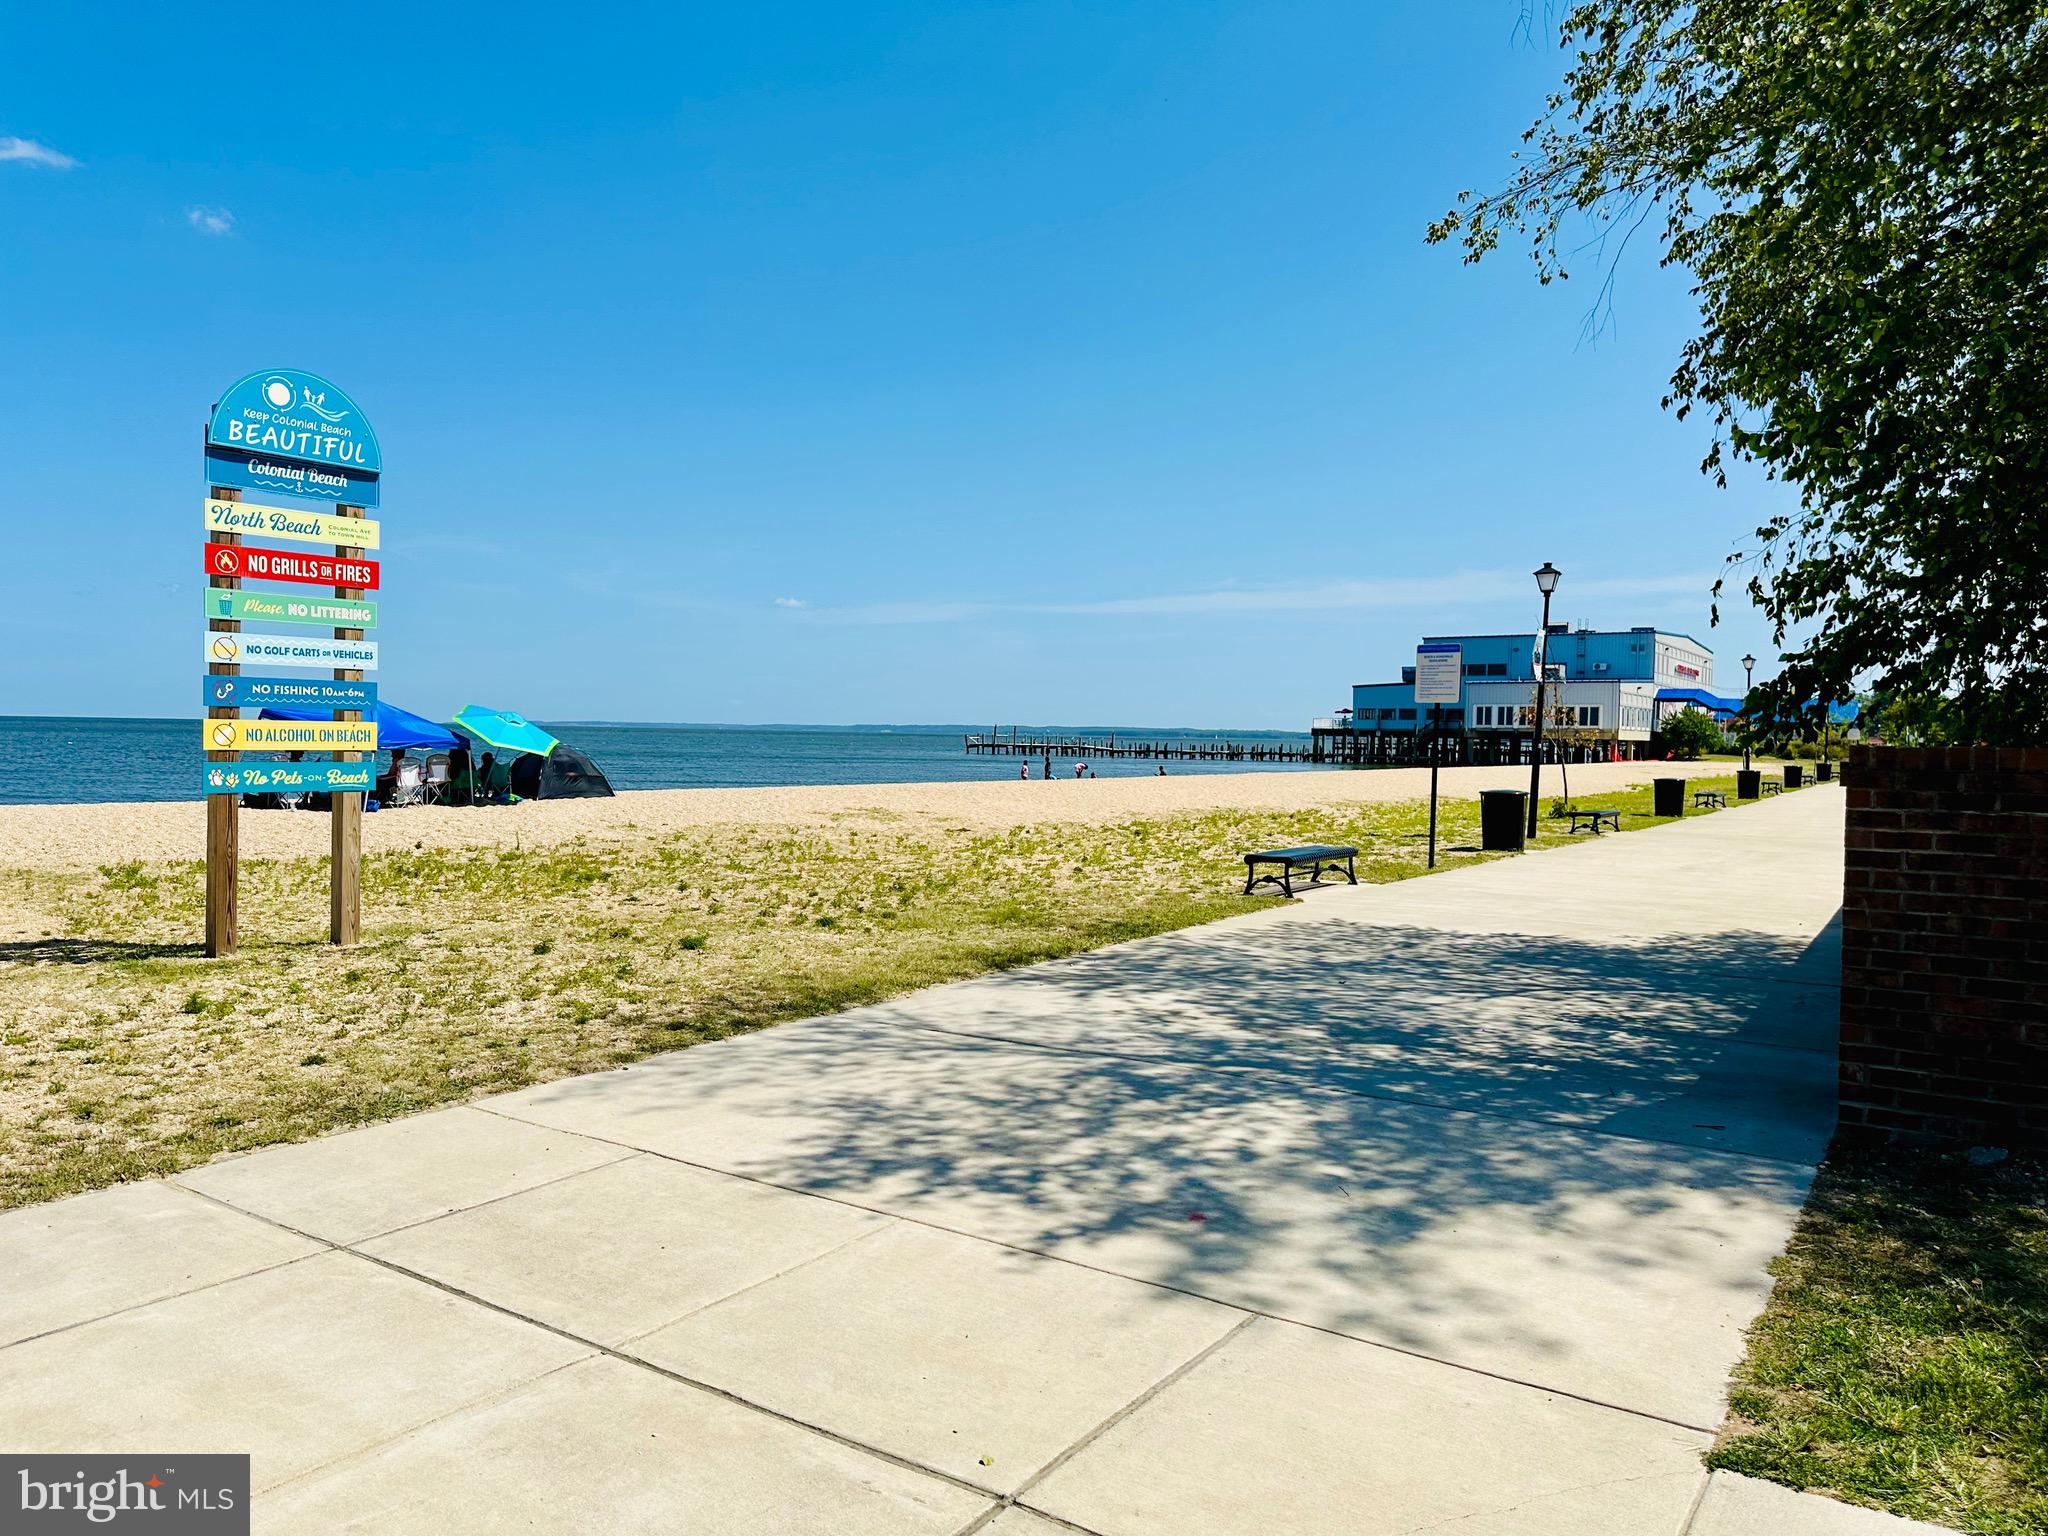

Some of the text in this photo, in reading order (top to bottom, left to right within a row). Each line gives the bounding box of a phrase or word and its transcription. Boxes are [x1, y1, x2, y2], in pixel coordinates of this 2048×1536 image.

[243, 407, 352, 438] Keep Colonial Beach
[229, 419, 366, 463] BEAUTIFUL
[248, 459, 348, 488] Colonial Beach
[211, 504, 322, 536] North Beach
[248, 554, 371, 584] NO GRILLS OR FIRES
[287, 603, 308, 617] NO
[310, 605, 372, 622] LITTERING
[246, 644, 262, 655] NO
[264, 646, 290, 656] GOLF
[292, 647, 321, 658] CARTS
[333, 650, 373, 660] VEHICLES
[252, 684, 365, 698] NO FISHING 10AM-6PM
[246, 728, 371, 743] NO ALCOHOL ON BEACH
[243, 769, 269, 786] No
[271, 769, 303, 785] Pets
[327, 768, 369, 784] Beach
